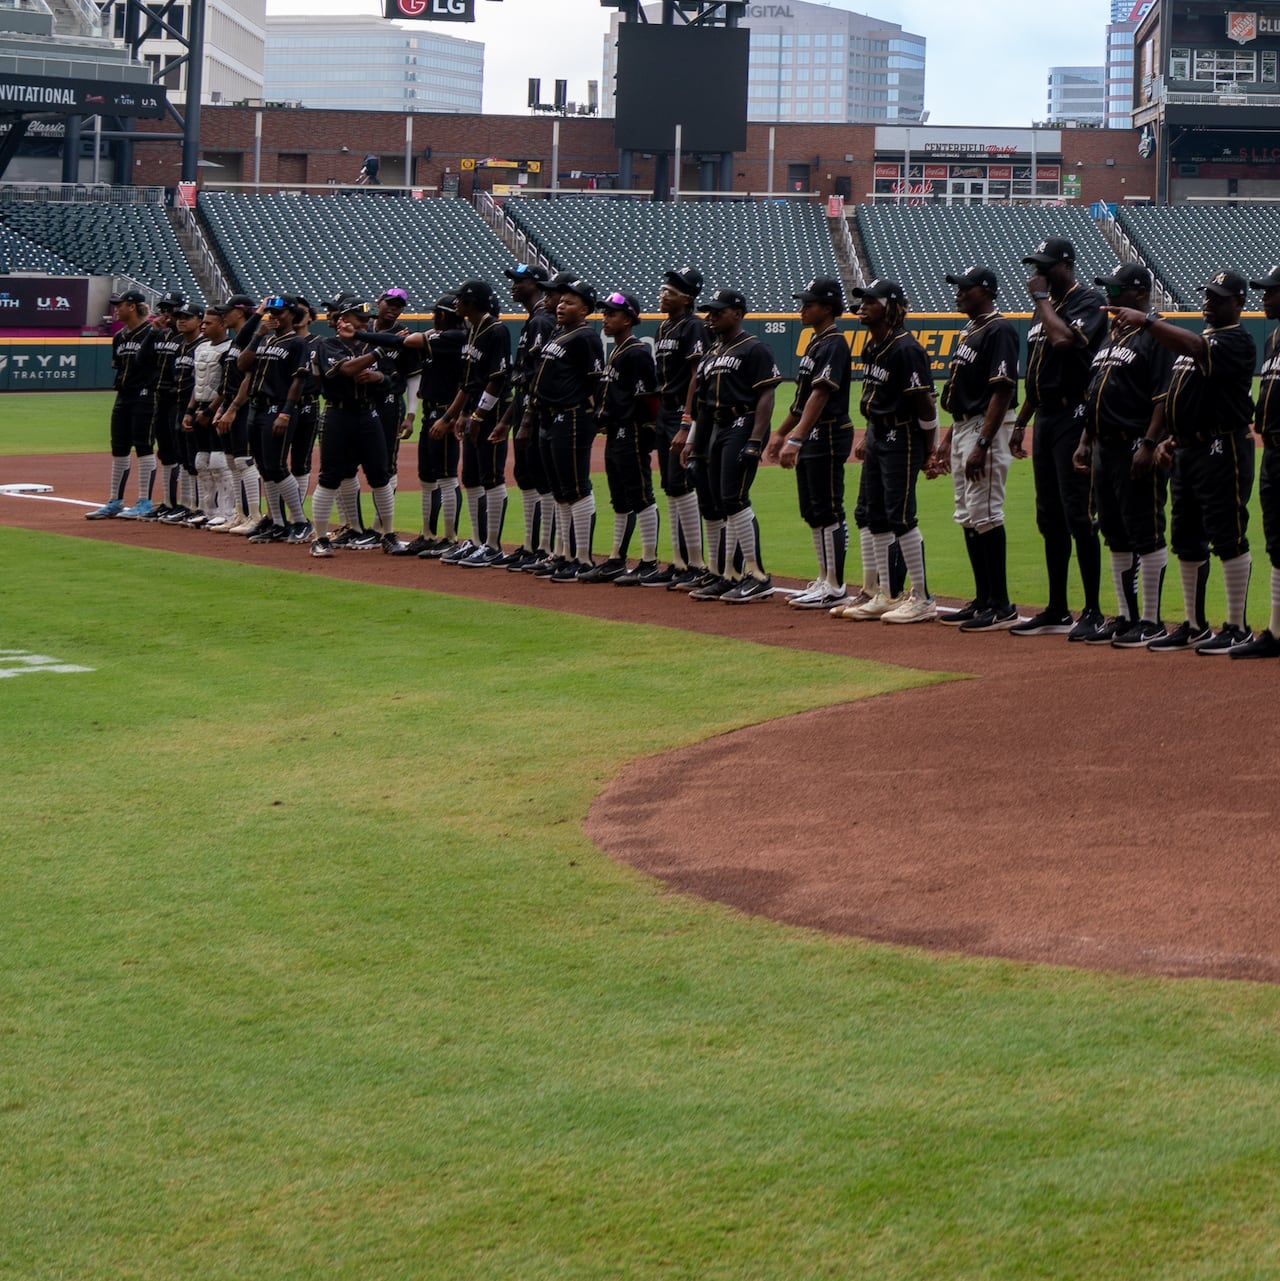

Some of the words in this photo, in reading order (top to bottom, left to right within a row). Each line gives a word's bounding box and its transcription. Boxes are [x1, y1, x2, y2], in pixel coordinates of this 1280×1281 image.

[746, 5, 794, 18] IGITAL
[925, 143, 985, 152] CENTERFIELD
[765, 322, 786, 333] 385
[12, 355, 76, 367] TYM
[13, 371, 76, 379] TRACTORS
